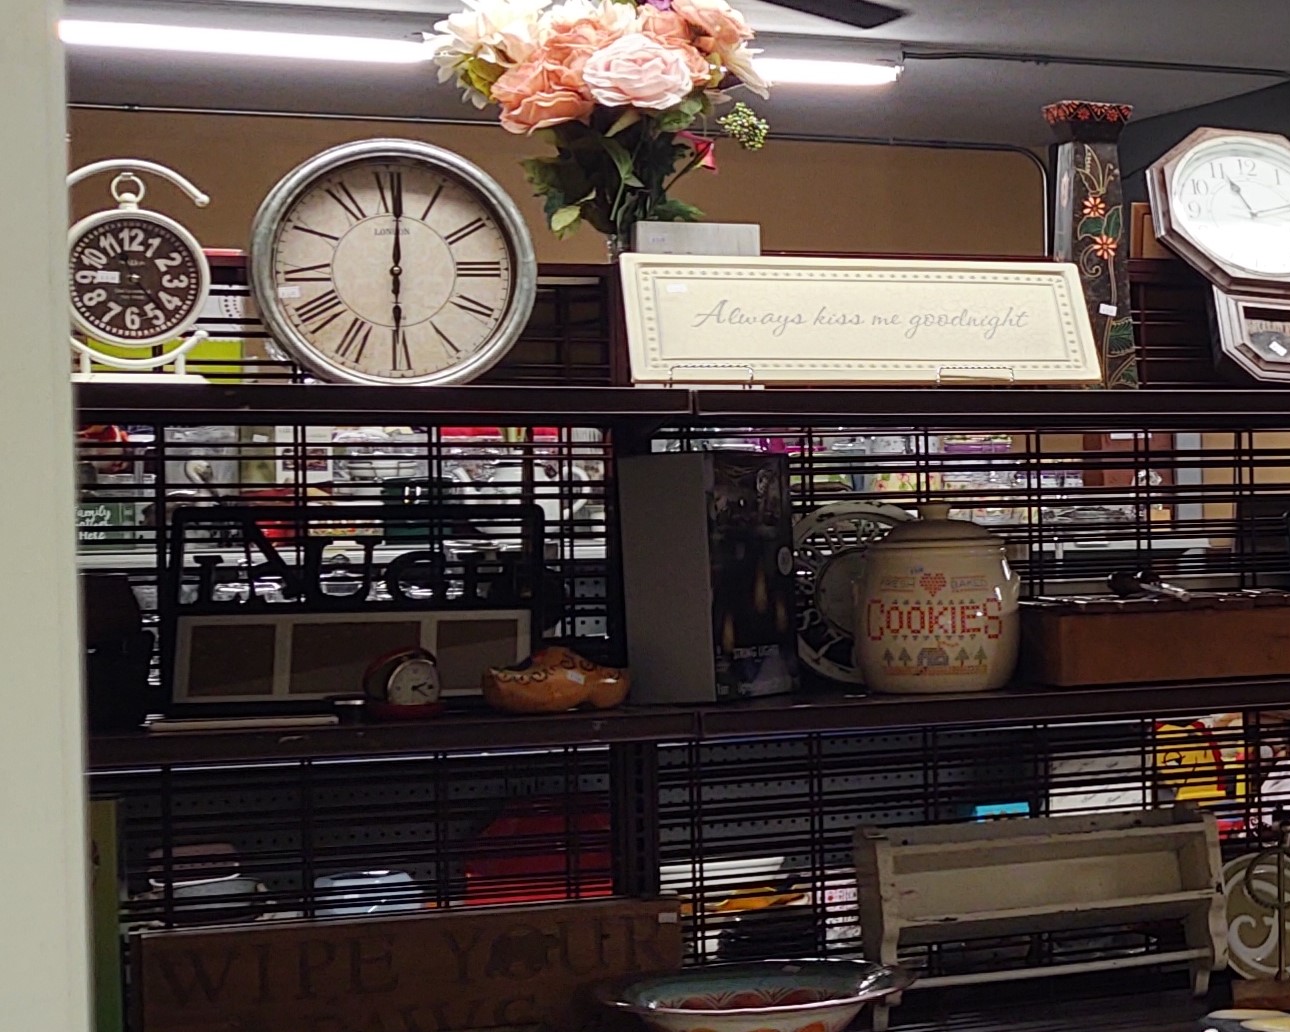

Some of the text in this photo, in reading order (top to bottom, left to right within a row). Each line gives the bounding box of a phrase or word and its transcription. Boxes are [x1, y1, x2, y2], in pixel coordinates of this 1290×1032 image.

[1238, 159, 1257, 176] 12
[99, 232, 122, 257] 11
[118, 227, 145, 252] 12
[145, 236, 162, 258] 1
[81, 247, 108, 269] 10
[154, 252, 182, 272] 2
[75, 270, 101, 284] 9
[161, 274, 189, 289] 3
[82, 288, 107, 307] 8
[158, 290, 183, 311] 4
[101, 301, 123, 323] 7
[124, 306, 141, 330] 6
[143, 302, 166, 326] 5
[692, 299, 1030, 340] Always kiss me goodnight
[867, 597, 1003, 641] COOKIES
[152, 915, 683, 1005] WIPE YOUR
